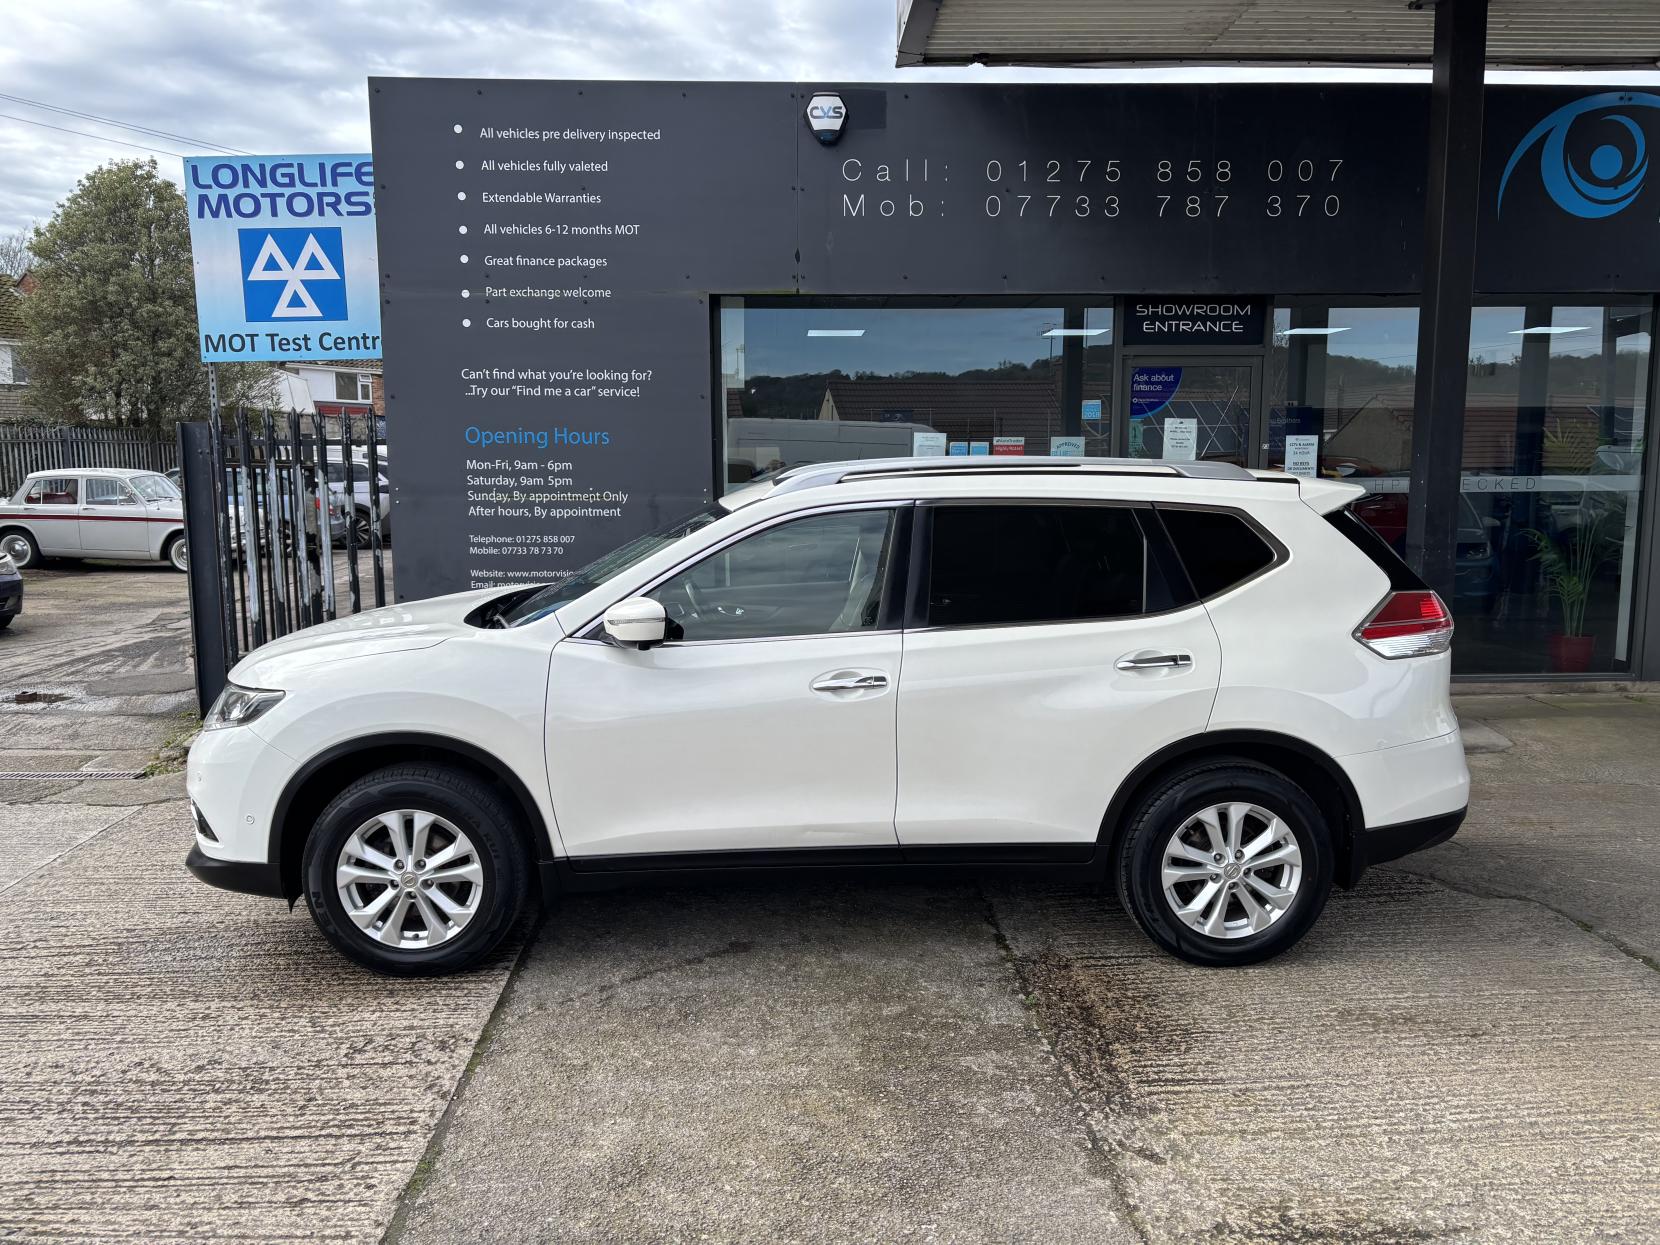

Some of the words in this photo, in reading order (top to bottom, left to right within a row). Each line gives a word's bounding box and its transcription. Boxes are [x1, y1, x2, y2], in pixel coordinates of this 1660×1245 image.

[810, 106, 843, 119] CVS
[479, 127, 494, 139] All
[495, 127, 540, 139] vehicles
[542, 130, 561, 142] pre
[562, 128, 606, 143] delivery
[608, 128, 661, 143] inspected
[481, 159, 495, 171] All
[497, 159, 541, 172] vehicles
[542, 159, 567, 174] fully
[568, 160, 608, 172] valeted
[842, 158, 950, 182] Call:
[986, 159, 1121, 184] 01275
[1156, 160, 1232, 183] 858
[1267, 159, 1344, 182] 007
[191, 162, 374, 190] LONGLIFE
[482, 191, 543, 203] Extendable
[544, 192, 602, 204] Warranties
[197, 190, 373, 220] MOTORS
[843, 193, 946, 217] Mob:
[985, 195, 1120, 218] 07733
[1156, 195, 1229, 218] 787
[1266, 194, 1340, 217] 370
[483, 223, 498, 235] All
[499, 223, 543, 235] vehicles
[544, 224, 569, 235] 6-12
[571, 223, 613, 235] months
[614, 224, 641, 235] MOT
[484, 255, 514, 266] Great
[515, 254, 556, 266] finance
[557, 255, 608, 269] packages
[485, 286, 508, 297] Part
[509, 286, 561, 300] exchange
[562, 286, 612, 298] welcome
[1135, 304, 1251, 316] SHOWROOM
[486, 317, 510, 328] Cars
[511, 317, 552, 331] bought
[553, 317, 569, 329] for
[570, 317, 595, 329] cash
[1142, 320, 1244, 333] ENTRANCE
[204, 333, 260, 353] MOT
[264, 332, 312, 353] Test
[318, 332, 382, 350] Centr
[461, 368, 491, 380] Can't
[492, 367, 515, 380] find
[517, 368, 547, 380] what
[548, 369, 584, 383] you're
[586, 368, 629, 384] looking
[630, 369, 653, 381] for?
[1133, 374, 1148, 382] Ask
[1150, 374, 1174, 382] about
[490, 387, 511, 396] our
[544, 387, 563, 397] me
[564, 388, 572, 397] a
[597, 385, 640, 398] service!
[1133, 383, 1163, 392] finance
[464, 426, 549, 449] Opening
[554, 426, 610, 446] Hours
[466, 459, 512, 472] Mon-Fri,
[513, 459, 538, 470] 9am
[547, 459, 573, 473] 6pm
[466, 474, 518, 489] Saturday,
[519, 475, 544, 486] 9am
[547, 475, 573, 488] 5pm
[1462, 477, 1536, 490] ECKED
[467, 490, 511, 504] Sunday,
[513, 490, 528, 504] By
[528, 490, 601, 504] appointment
[602, 490, 629, 505] Only
[468, 505, 496, 517] After
[497, 505, 532, 518] hours,
[534, 506, 548, 519] By
[549, 506, 622, 519] appointment
[468, 534, 515, 545] Telephone:
[515, 535, 542, 544] 01275
[542, 535, 559, 544] 858
[559, 535, 576, 544] 007
[469, 546, 501, 555] Mobile:
[501, 546, 528, 555] 07733
[470, 569, 506, 578] Website:
